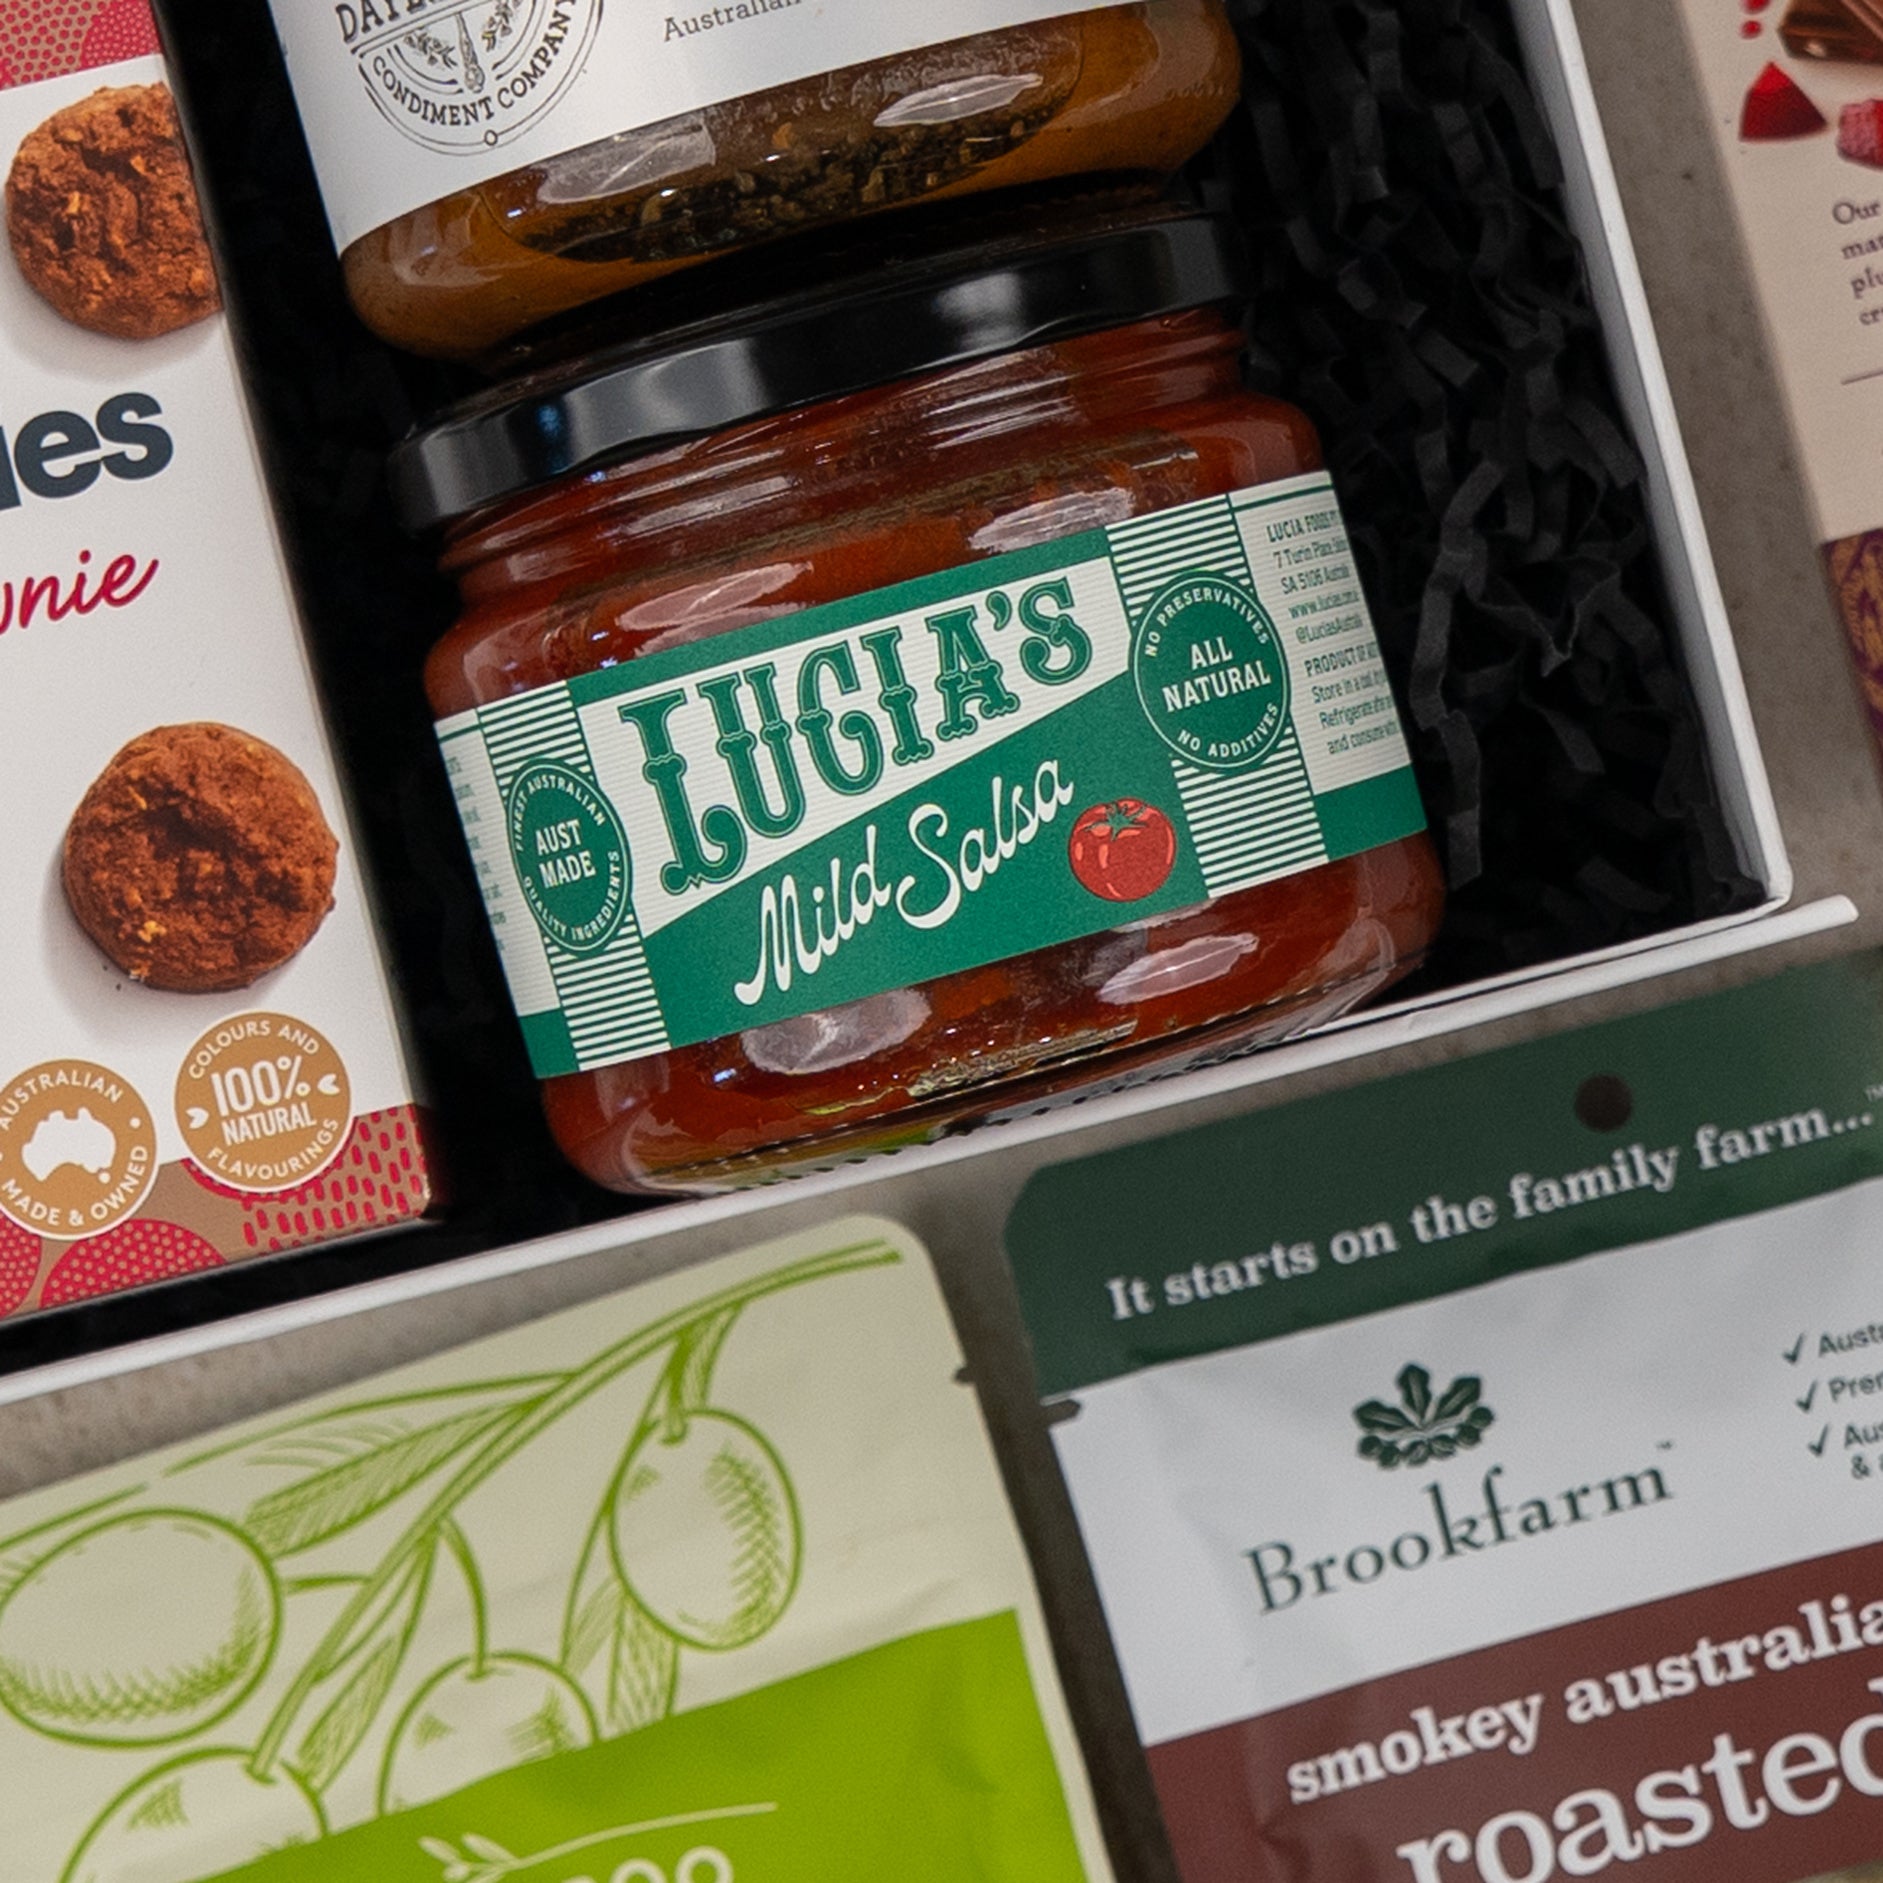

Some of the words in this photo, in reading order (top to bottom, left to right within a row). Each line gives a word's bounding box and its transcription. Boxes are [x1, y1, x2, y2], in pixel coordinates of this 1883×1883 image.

[373, 56, 494, 125] CONDIMENT
[497, 0, 576, 108] COMPAN
[1832, 202, 1881, 224] Our
[1267, 517, 1303, 542] LUCIA
[1281, 575, 1297, 594] SA
[1145, 631, 1161, 658] NO
[1157, 587, 1269, 645] PRESERVATIVES
[1191, 637, 1233, 670] ALL
[1304, 648, 1356, 676] PRODUCT
[1162, 660, 1272, 713] NATURAL
[1312, 679, 1342, 703] Store
[617, 576, 1093, 896] LUCIA'S
[1178, 729, 1201, 751] NO
[1208, 702, 1278, 758] ADDITIVES
[1327, 734, 1348, 754] and
[514, 791, 528, 852] FINEST
[527, 774, 606, 827] AUSTRALIAN
[535, 818, 582, 856] AUST
[523, 875, 567, 937] QUALITY
[571, 850, 621, 941] INGREDIENTS
[539, 850, 597, 889] MADE
[734, 825, 890, 1006] Mild
[897, 759, 1074, 929] Salsa
[189, 1020, 271, 1079] COLOURS
[278, 1024, 320, 1055] AND
[0, 1069, 123, 1131] AUSTRALIAN
[211, 1055, 311, 1117] 100%
[207, 1118, 339, 1181] FLAVOURINGS
[221, 1101, 317, 1146] NATURAL
[2, 1178, 60, 1226] MADE
[69, 1209, 84, 1227] &
[90, 1145, 148, 1220] OWNED
[1106, 1274, 1156, 1321] It
[1163, 1241, 1319, 1306] starts
[1329, 1221, 1399, 1265] on
[1410, 1194, 1498, 1244] the
[1508, 1143, 1679, 1220] family
[1241, 1464, 1675, 1616] Brookfarm
[1286, 1693, 1543, 1805] smokey
